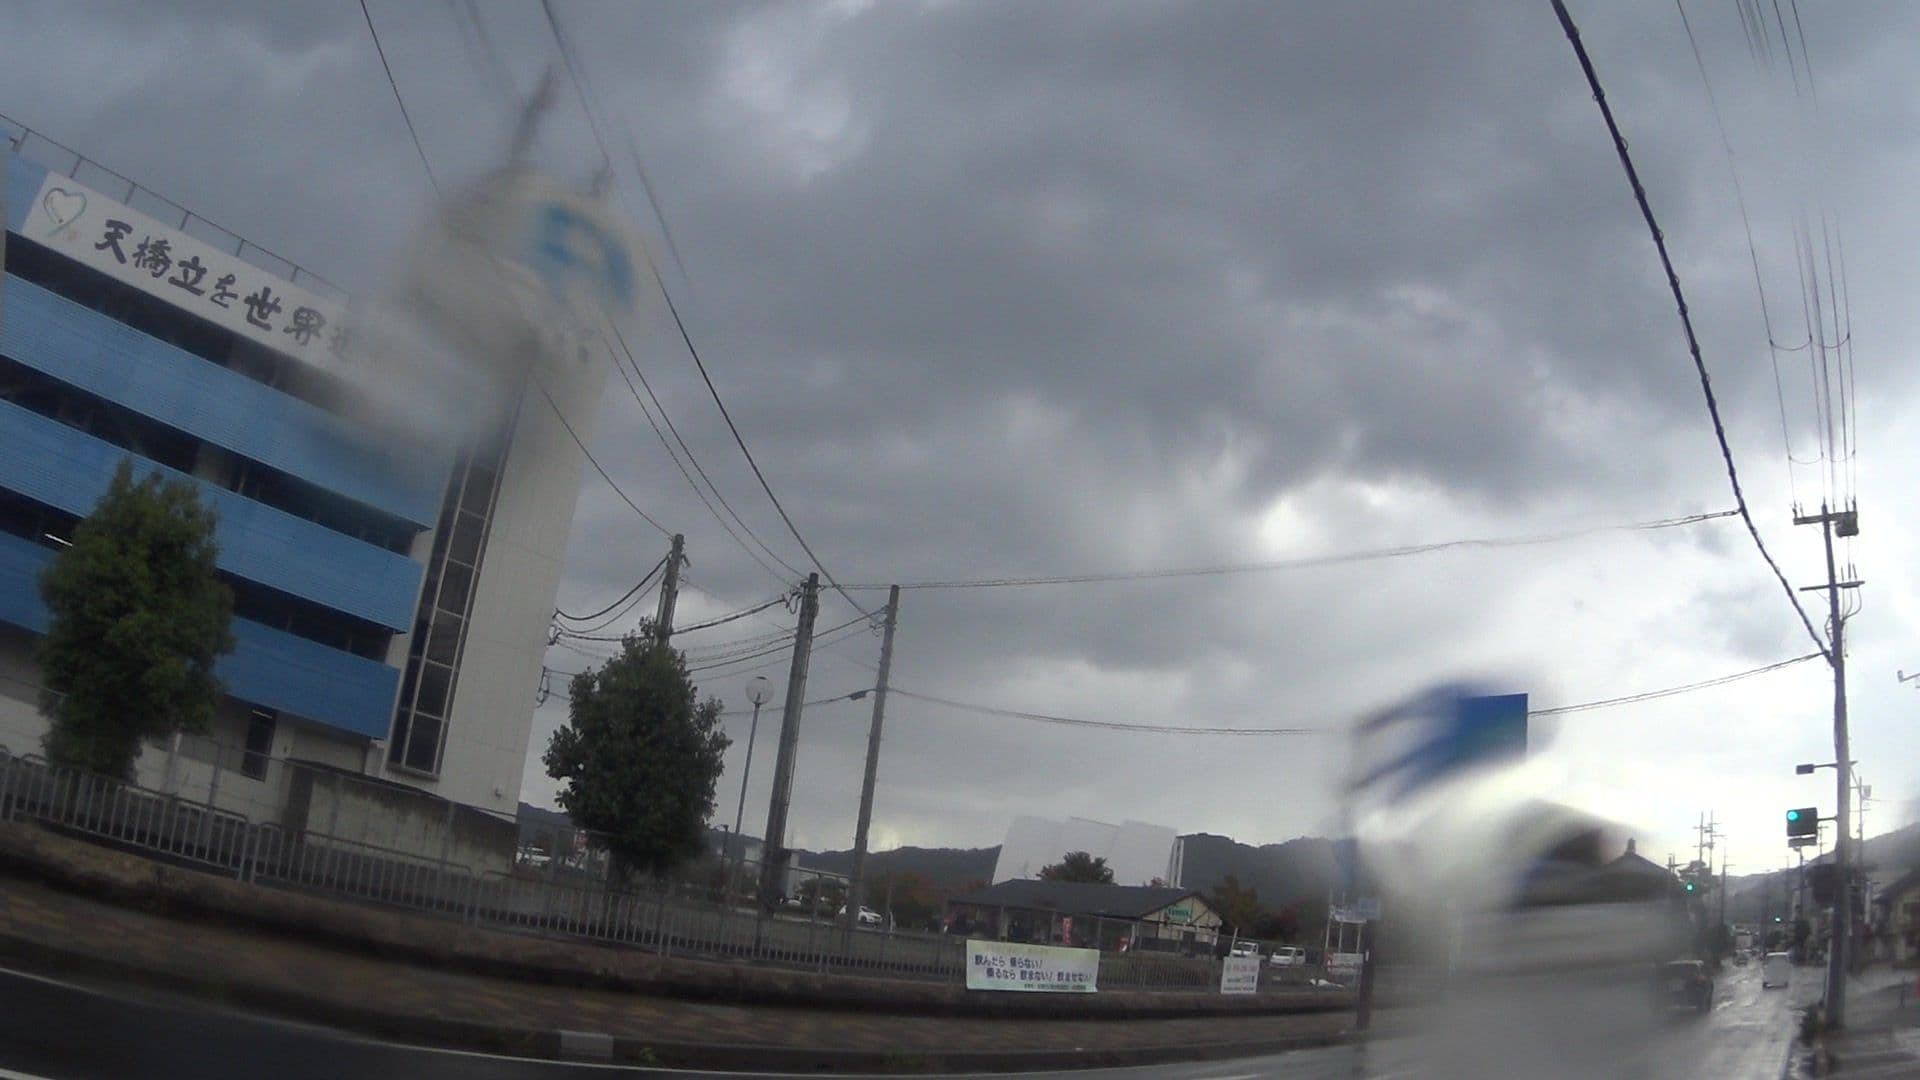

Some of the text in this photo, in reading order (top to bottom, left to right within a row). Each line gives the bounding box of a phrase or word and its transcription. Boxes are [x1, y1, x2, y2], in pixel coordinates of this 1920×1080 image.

[94, 219, 350, 353] 天橋立を世界
